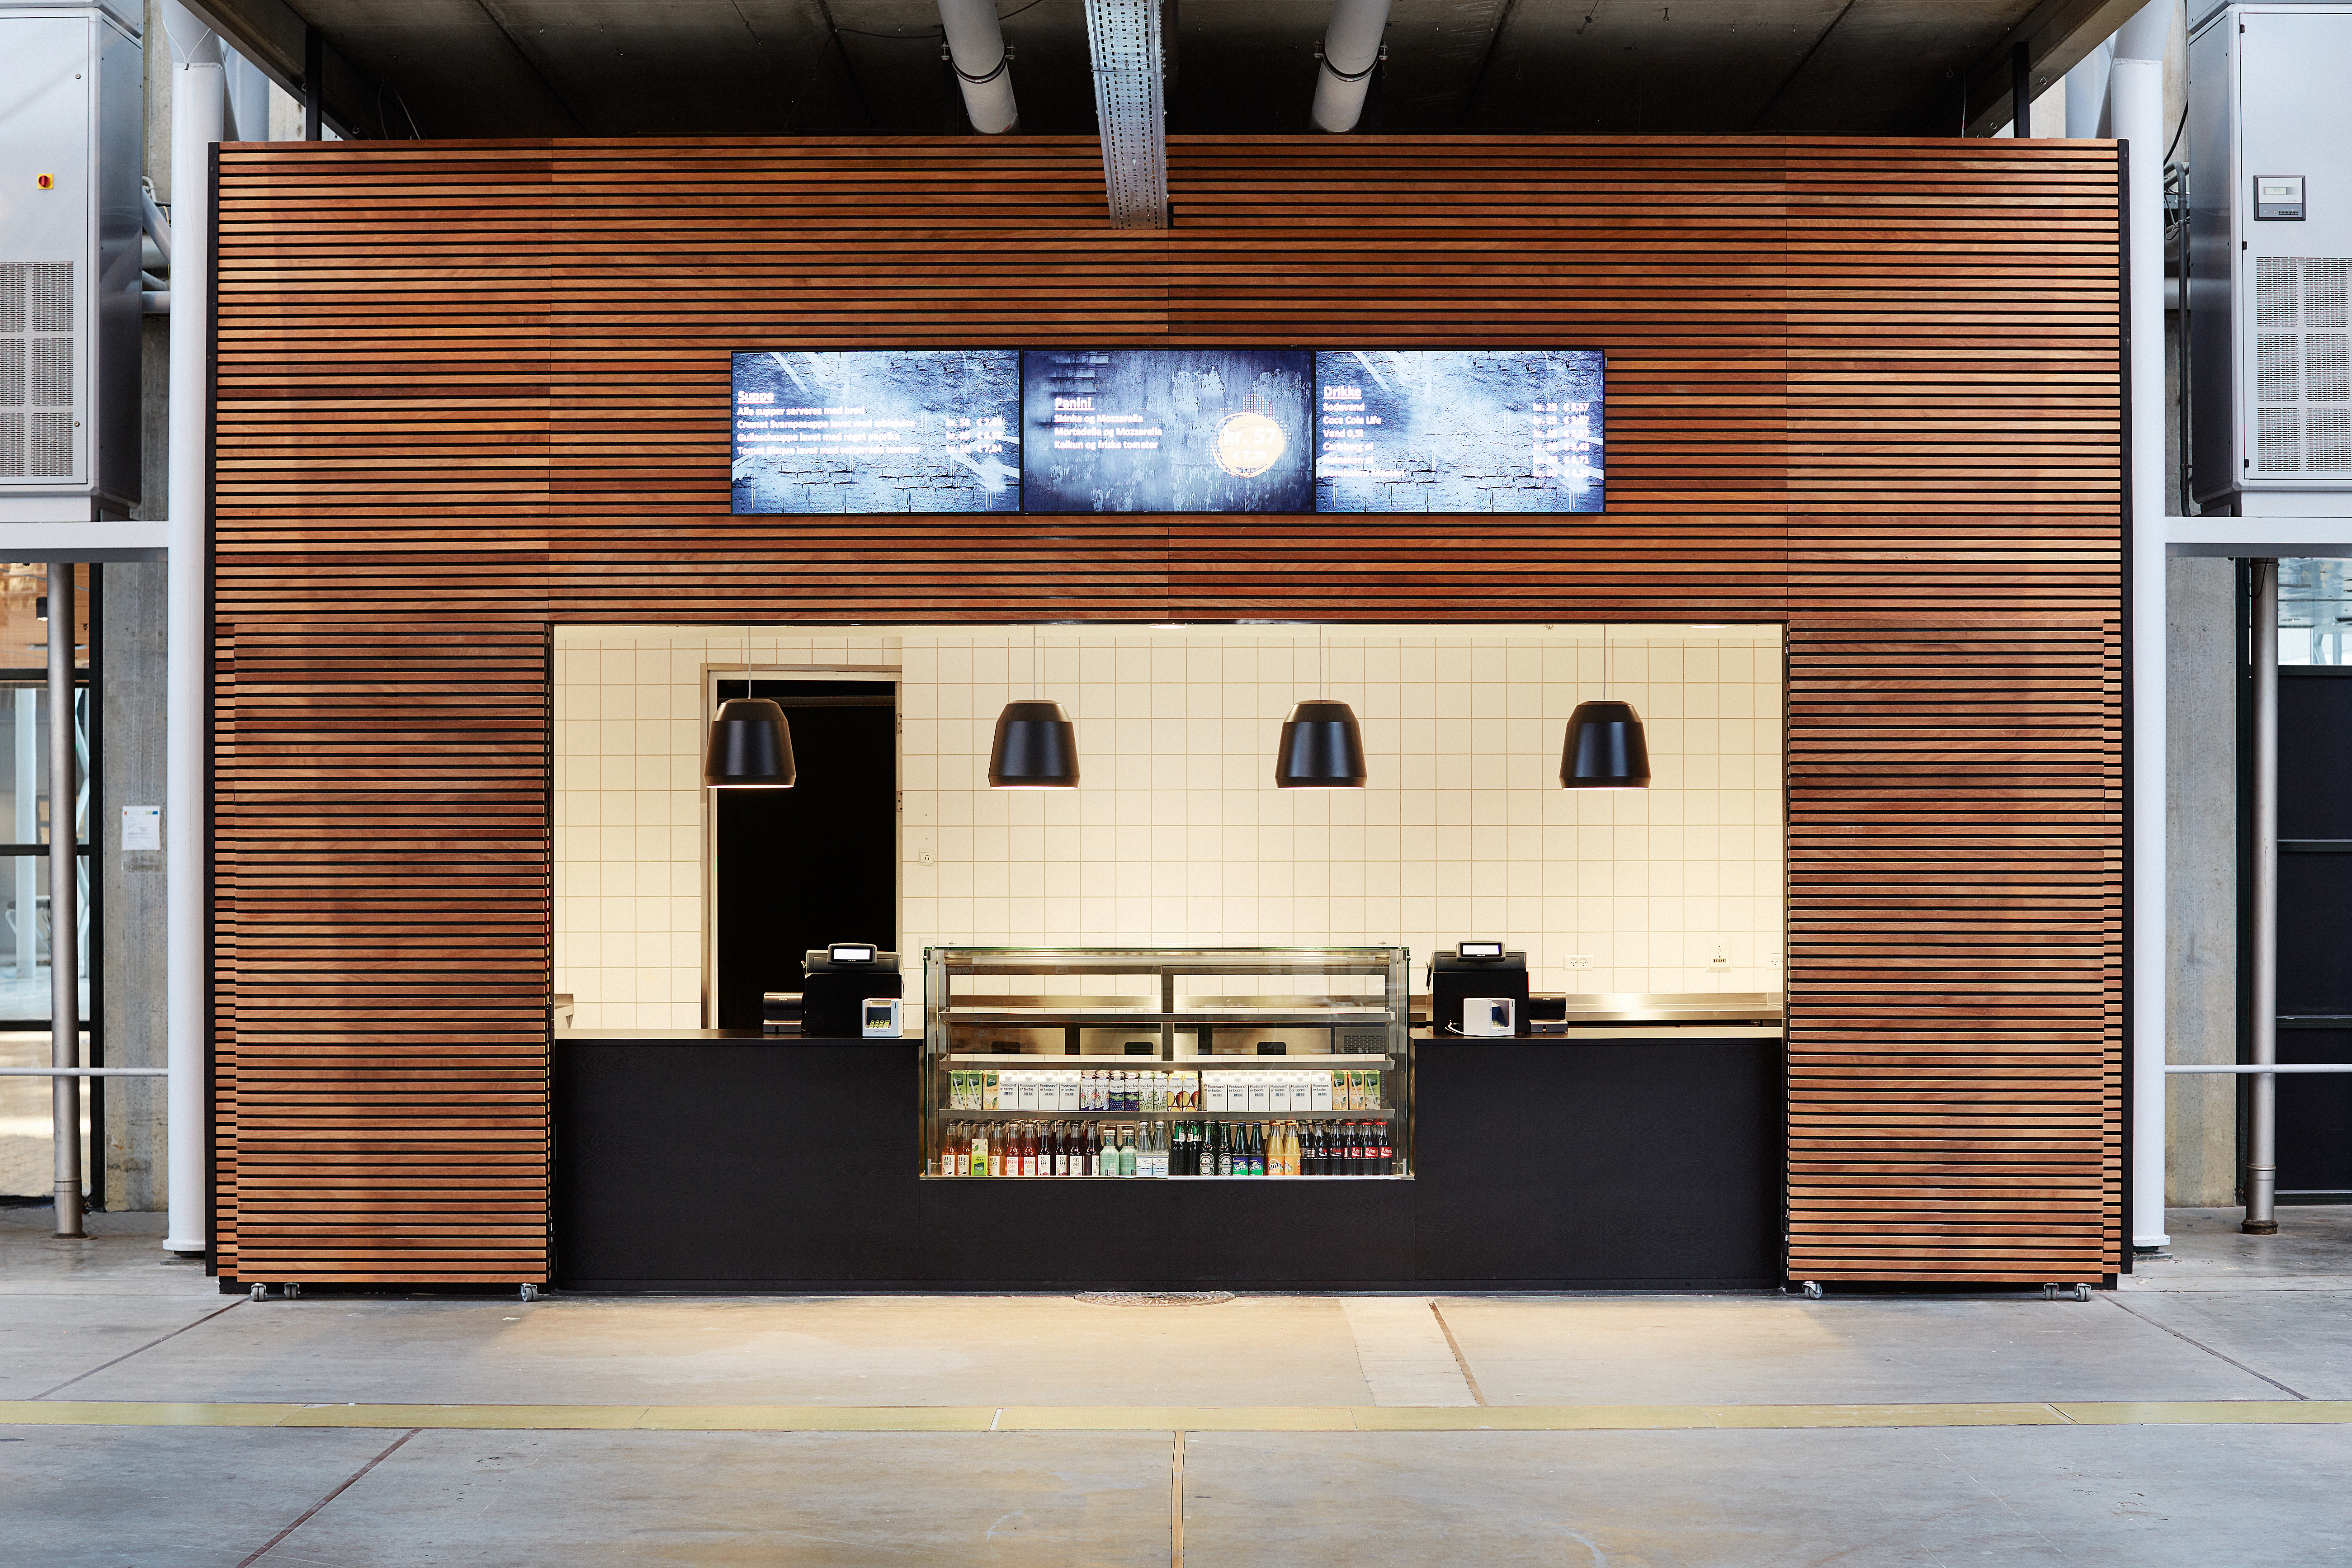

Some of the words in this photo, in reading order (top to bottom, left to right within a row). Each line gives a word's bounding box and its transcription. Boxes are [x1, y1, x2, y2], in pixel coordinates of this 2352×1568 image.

[1323, 385, 1362, 397] Drikke
[737, 390, 775, 403] Suppe
[1054, 397, 1092, 408] Panini
[1322, 402, 1365, 411] Sodavand
[1546, 402, 1558, 411] 25
[737, 407, 754, 416] Alle
[755, 408, 785, 417] supper
[824, 406, 843, 415] med
[853, 419, 872, 428] med
[1054, 414, 1082, 423] Skinke
[1084, 416, 1095, 424] og
[1097, 414, 1143, 423] Mozzarella
[1322, 416, 1344, 425] Coca
[1345, 416, 1365, 425] Cola
[1366, 416, 1382, 425] Life
[1546, 416, 1558, 425] 25
[822, 432, 842, 441] med
[1054, 427, 1102, 436] Mortadella
[1103, 429, 1115, 437] og
[1116, 427, 1162, 436] Mozzarella
[1223, 426, 1248, 444] kr.
[1254, 427, 1277, 444] 57
[1322, 429, 1346, 438] Vand
[819, 445, 839, 454] med
[1054, 440, 1084, 449] Kalkun
[1085, 442, 1096, 451] og
[1098, 440, 1122, 449] friske
[1123, 441, 1158, 449] tomater
[1322, 442, 1363, 453] Carlsberg
[1233, 450, 1240, 460] €
[1243, 450, 1266, 462] 7,70
